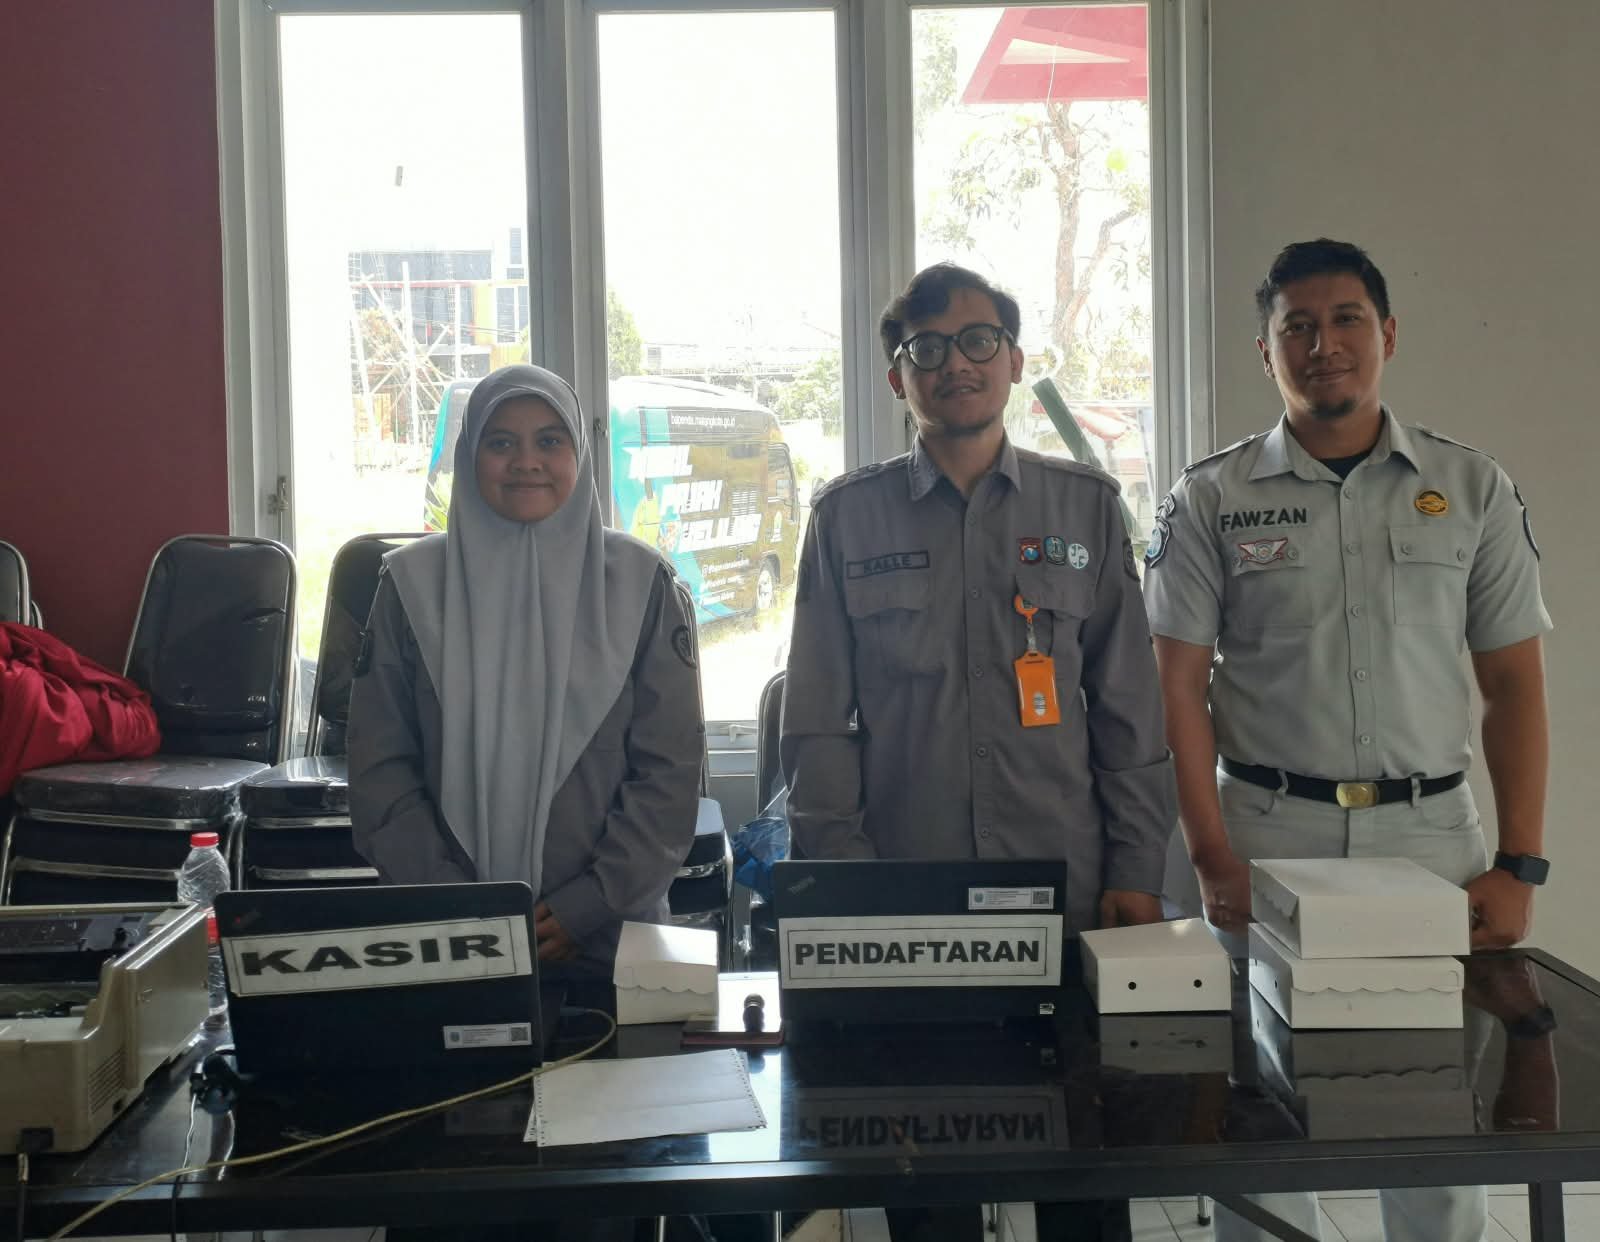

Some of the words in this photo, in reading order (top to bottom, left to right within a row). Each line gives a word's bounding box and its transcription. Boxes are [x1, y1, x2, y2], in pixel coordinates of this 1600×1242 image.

[1220, 507, 1307, 532] FAWZAN
[240, 934, 505, 976] KASIR
[794, 940, 1040, 966] PENDAFTARAN
